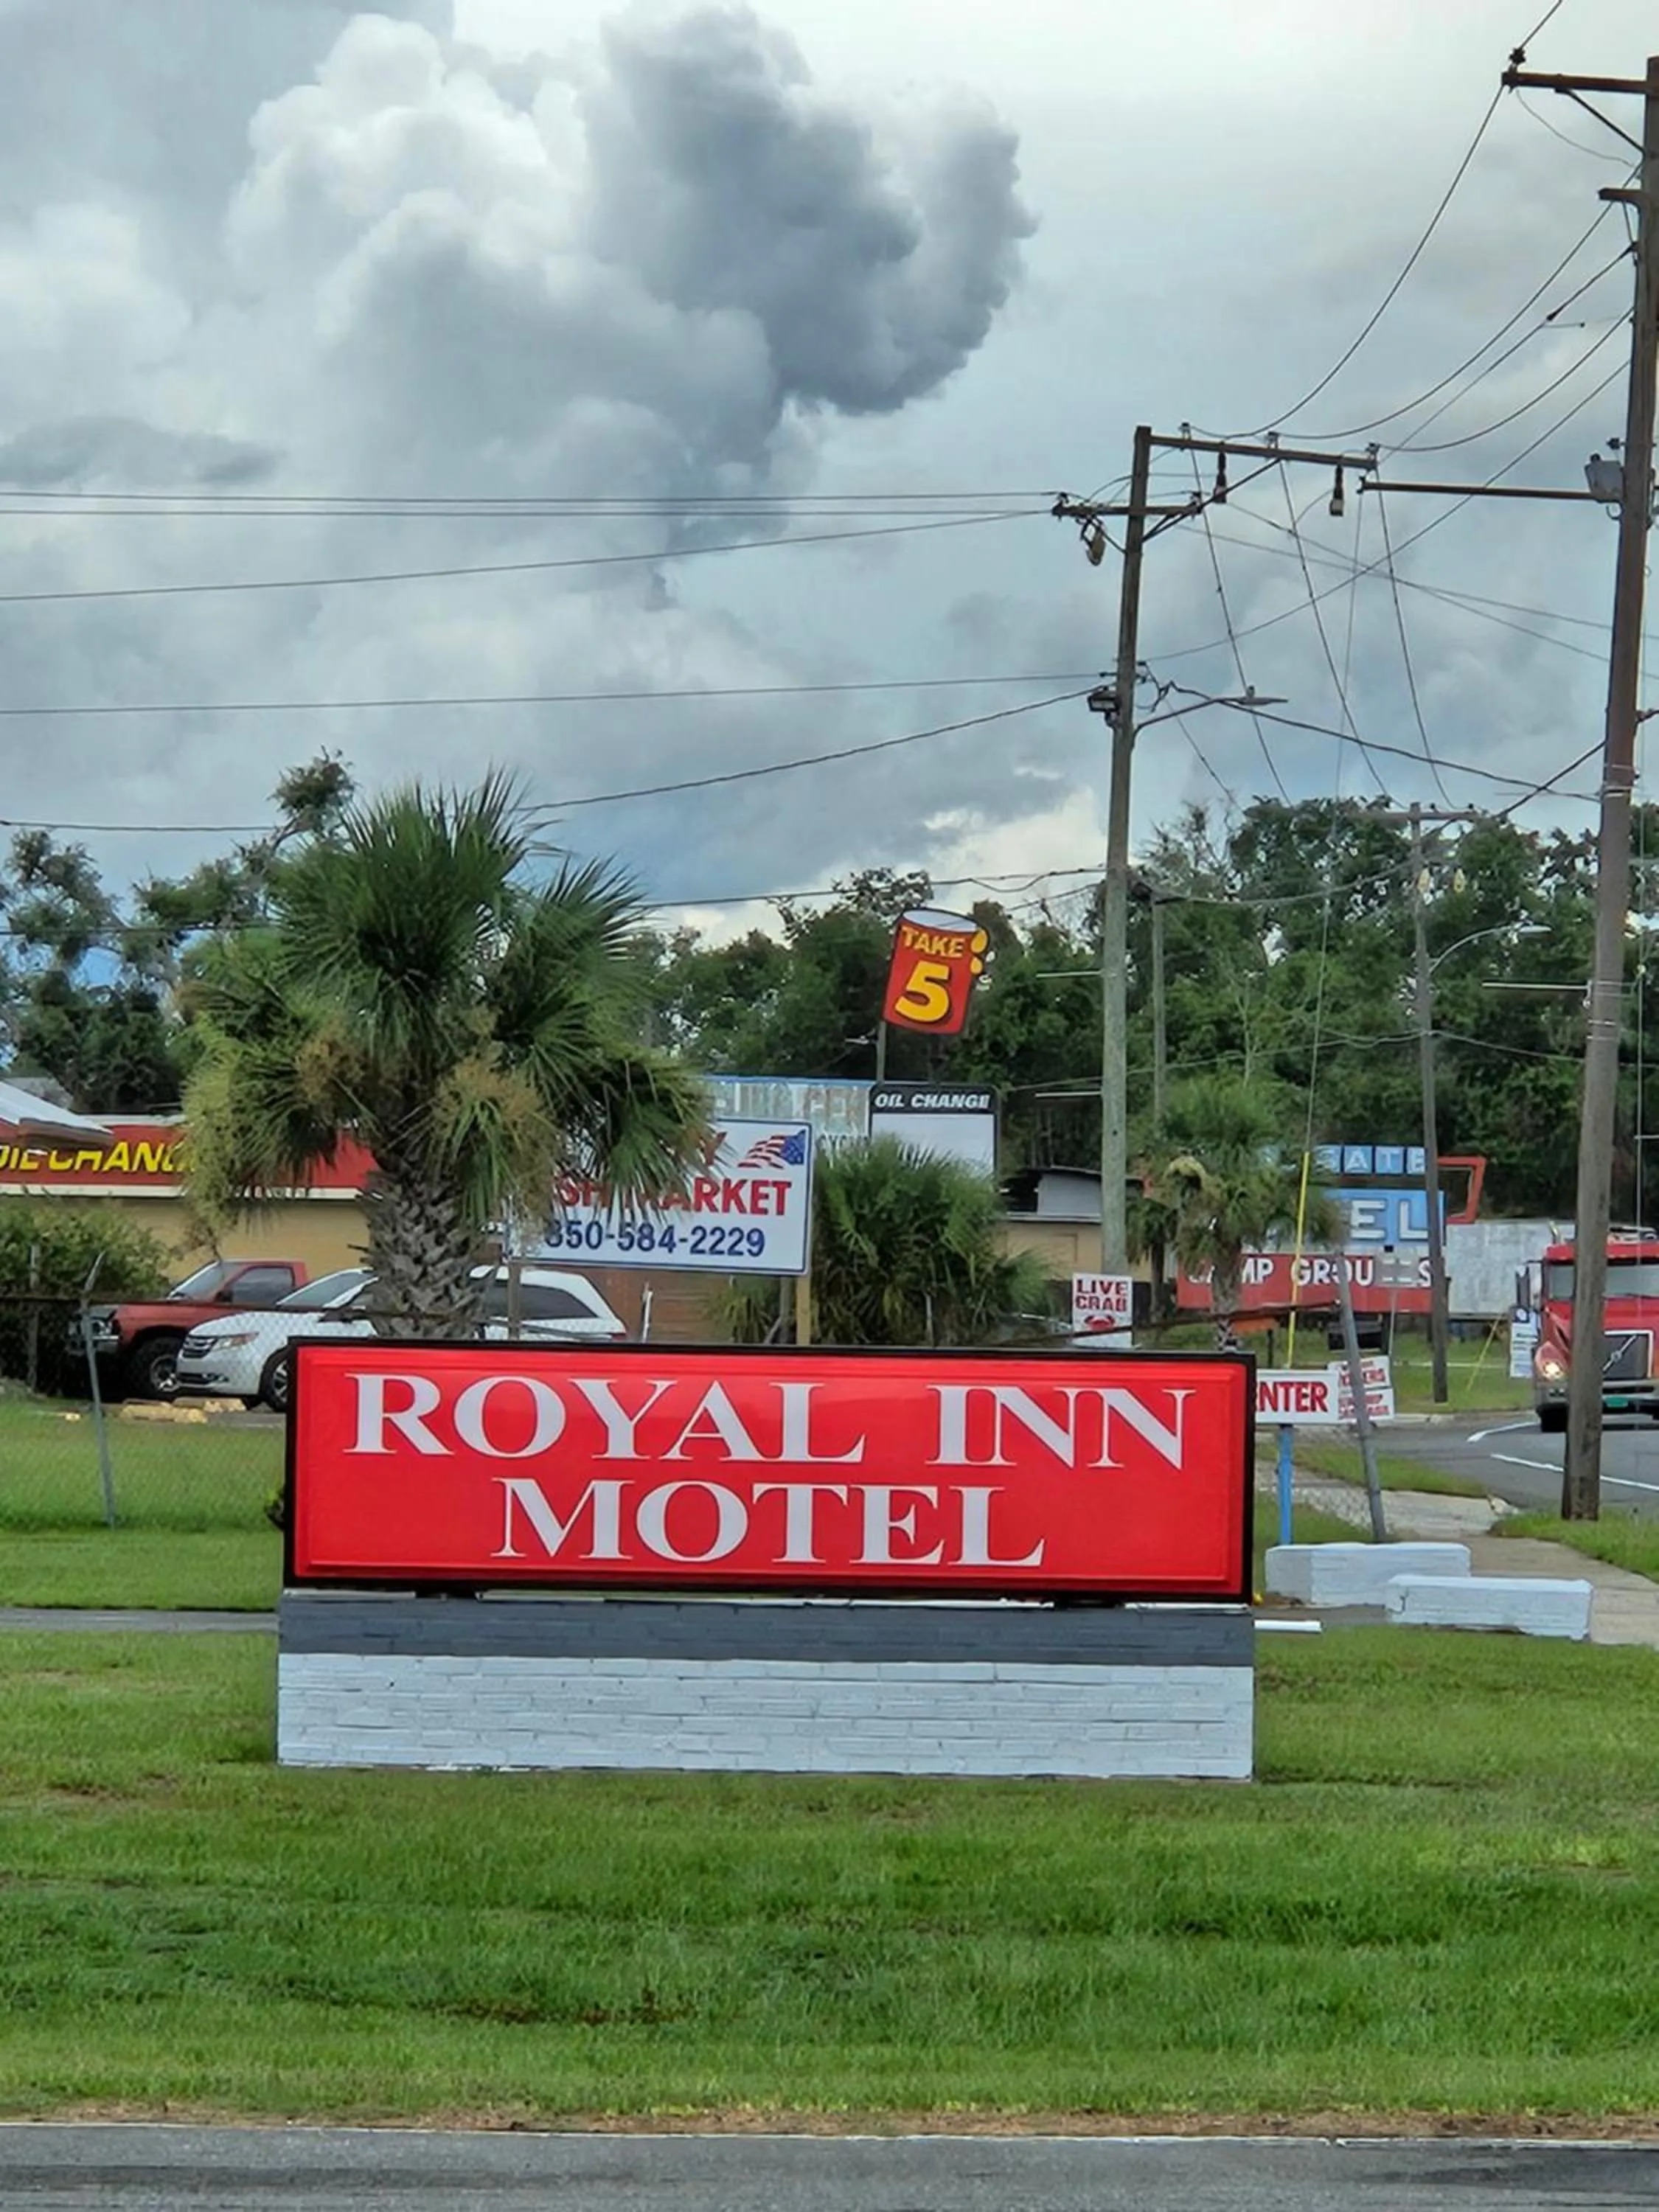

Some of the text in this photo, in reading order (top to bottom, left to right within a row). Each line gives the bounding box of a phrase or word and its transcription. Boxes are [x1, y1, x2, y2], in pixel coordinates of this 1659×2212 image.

[901, 926, 966, 959] TAKE
[894, 960, 951, 1023] 5
[874, 1093, 991, 1108] OIL CHANGE
[1076, 1295, 1127, 1312] CRAB
[1077, 1279, 1128, 1296] LIVE
[1258, 1381, 1329, 1413] NTER
[351, 1373, 1194, 1470] ROYAL INN
[491, 1477, 1045, 1567] MOTEL
